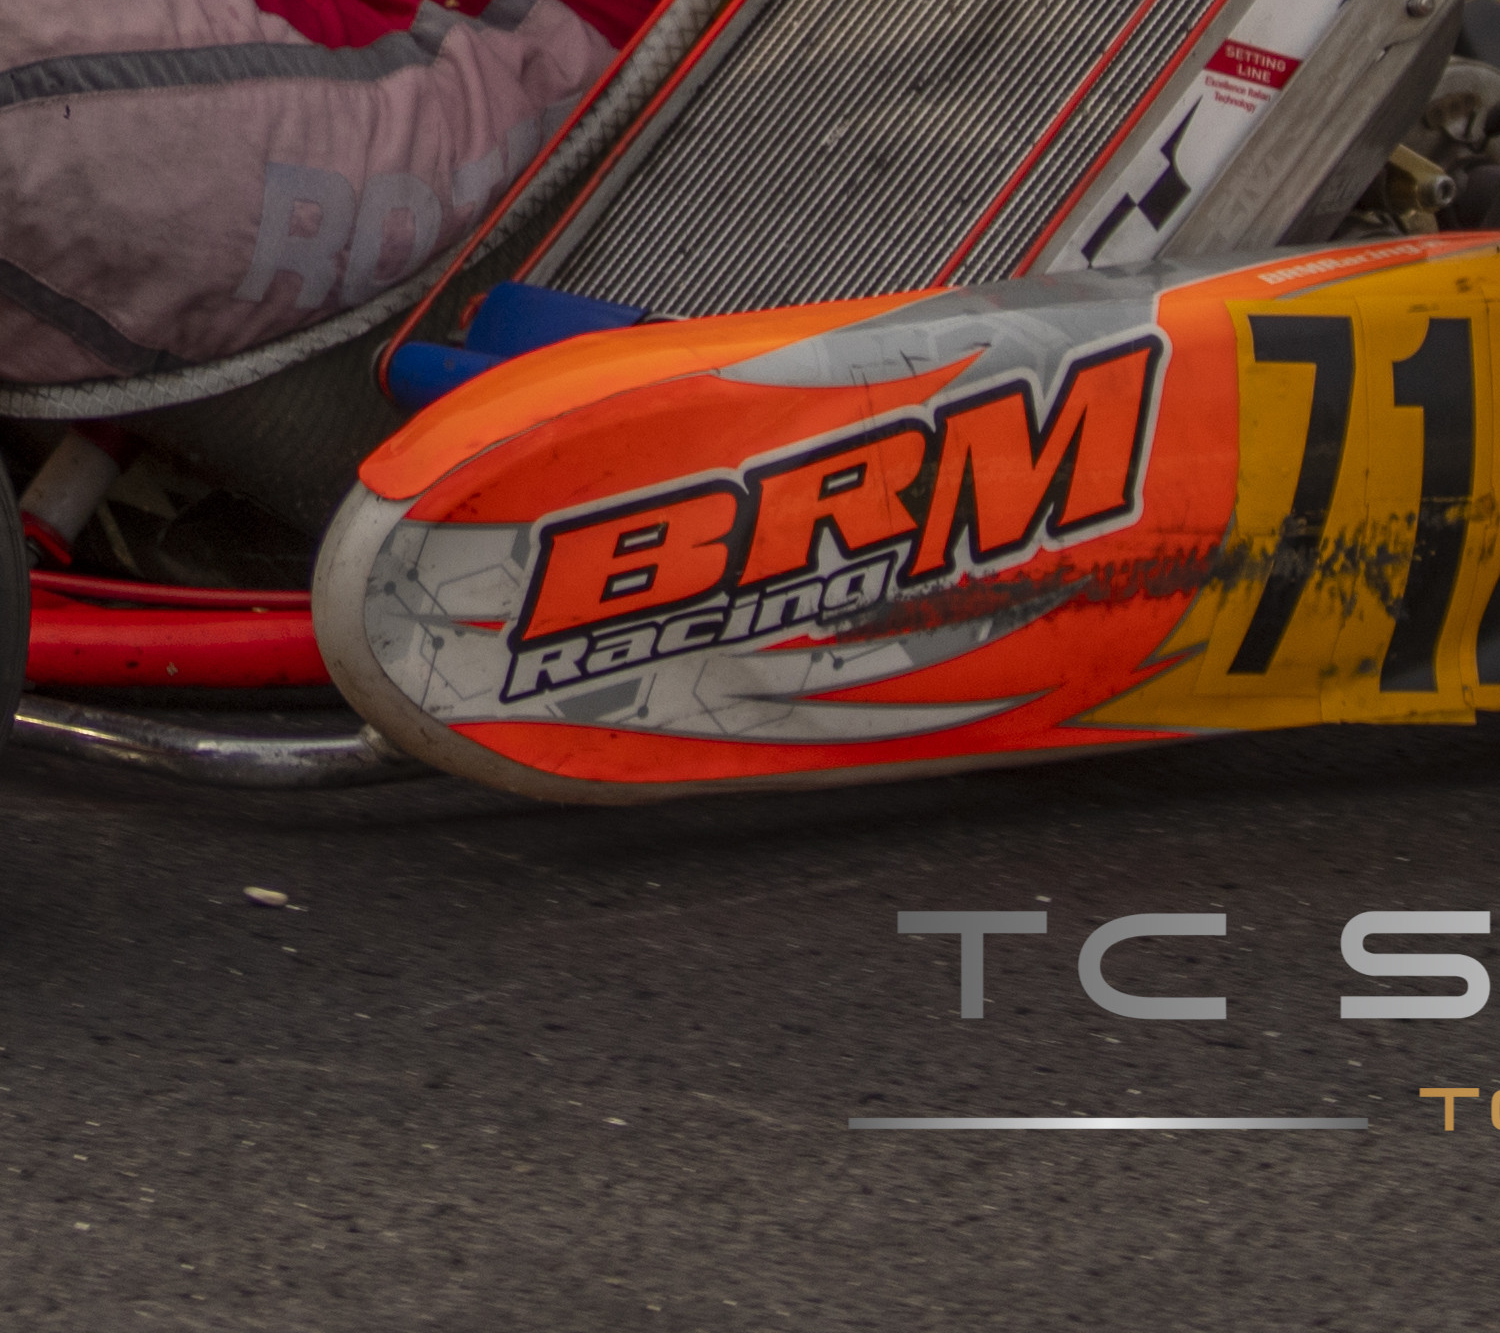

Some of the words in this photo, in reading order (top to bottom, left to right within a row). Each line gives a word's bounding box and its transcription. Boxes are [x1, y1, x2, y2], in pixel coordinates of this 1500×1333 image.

[1224, 45, 1287, 74] SETTING
[1237, 63, 1271, 84] LINE
[521, 332, 1162, 646] BRM
[502, 551, 898, 702] Racing
